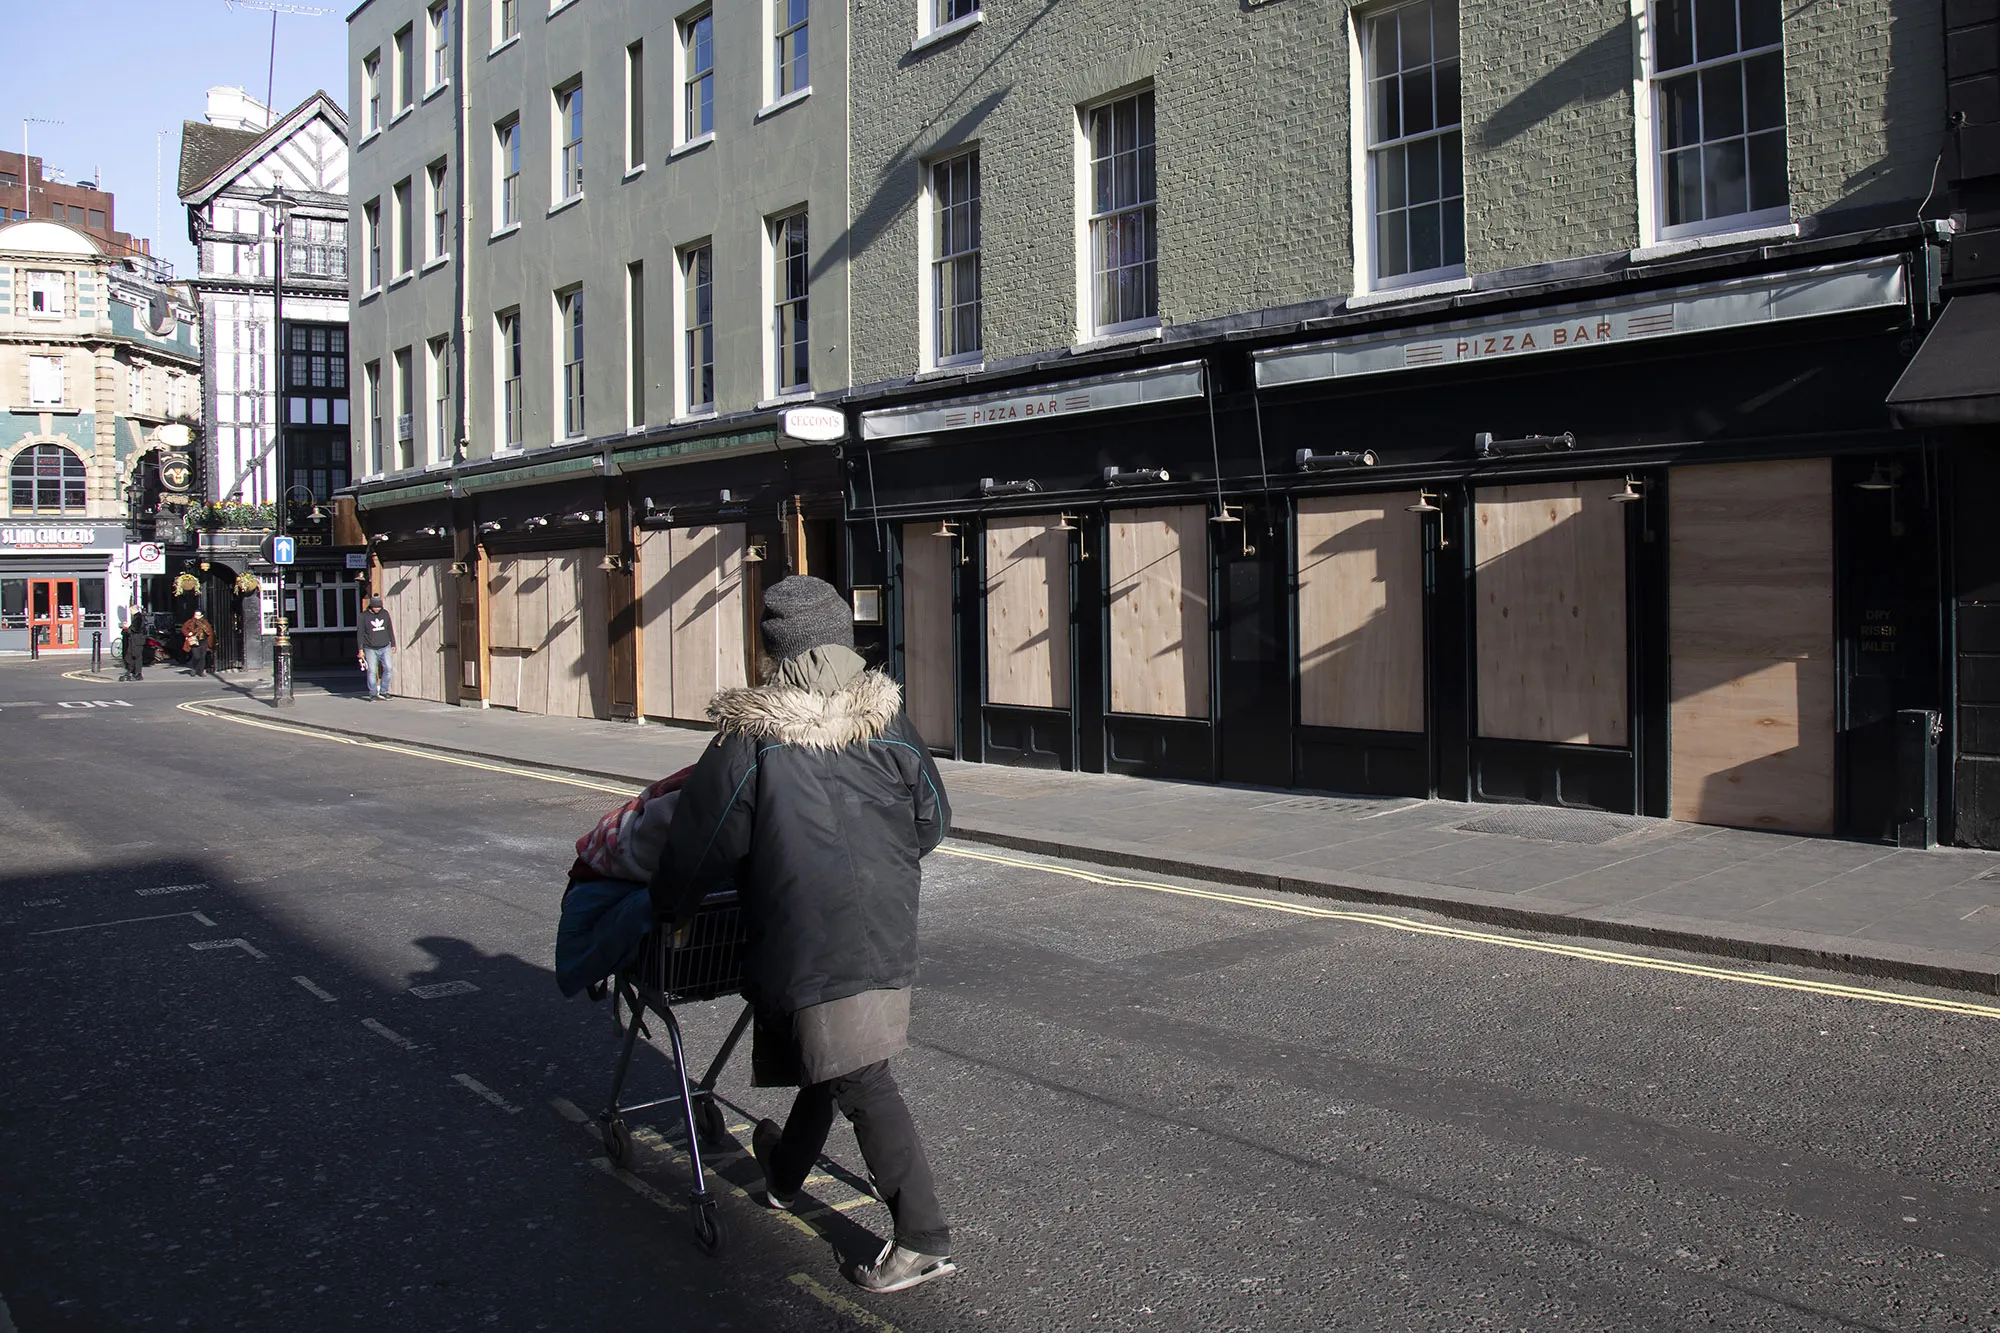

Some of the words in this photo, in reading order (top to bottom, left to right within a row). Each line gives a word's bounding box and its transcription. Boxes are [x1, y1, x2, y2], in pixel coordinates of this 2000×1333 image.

[1456, 332, 1536, 358] PIZZA
[1553, 322, 1611, 345] BAR
[973, 406, 1017, 424] PIZZA
[1025, 400, 1057, 416] BAR
[790, 414, 841, 428] CECCONI'S
[2, 528, 35, 544] SLIM
[36, 528, 95, 544] CHICKENS
[1865, 609, 1892, 621] DRY
[1860, 625, 1897, 636] RISER
[1861, 641, 1898, 652] INLET
